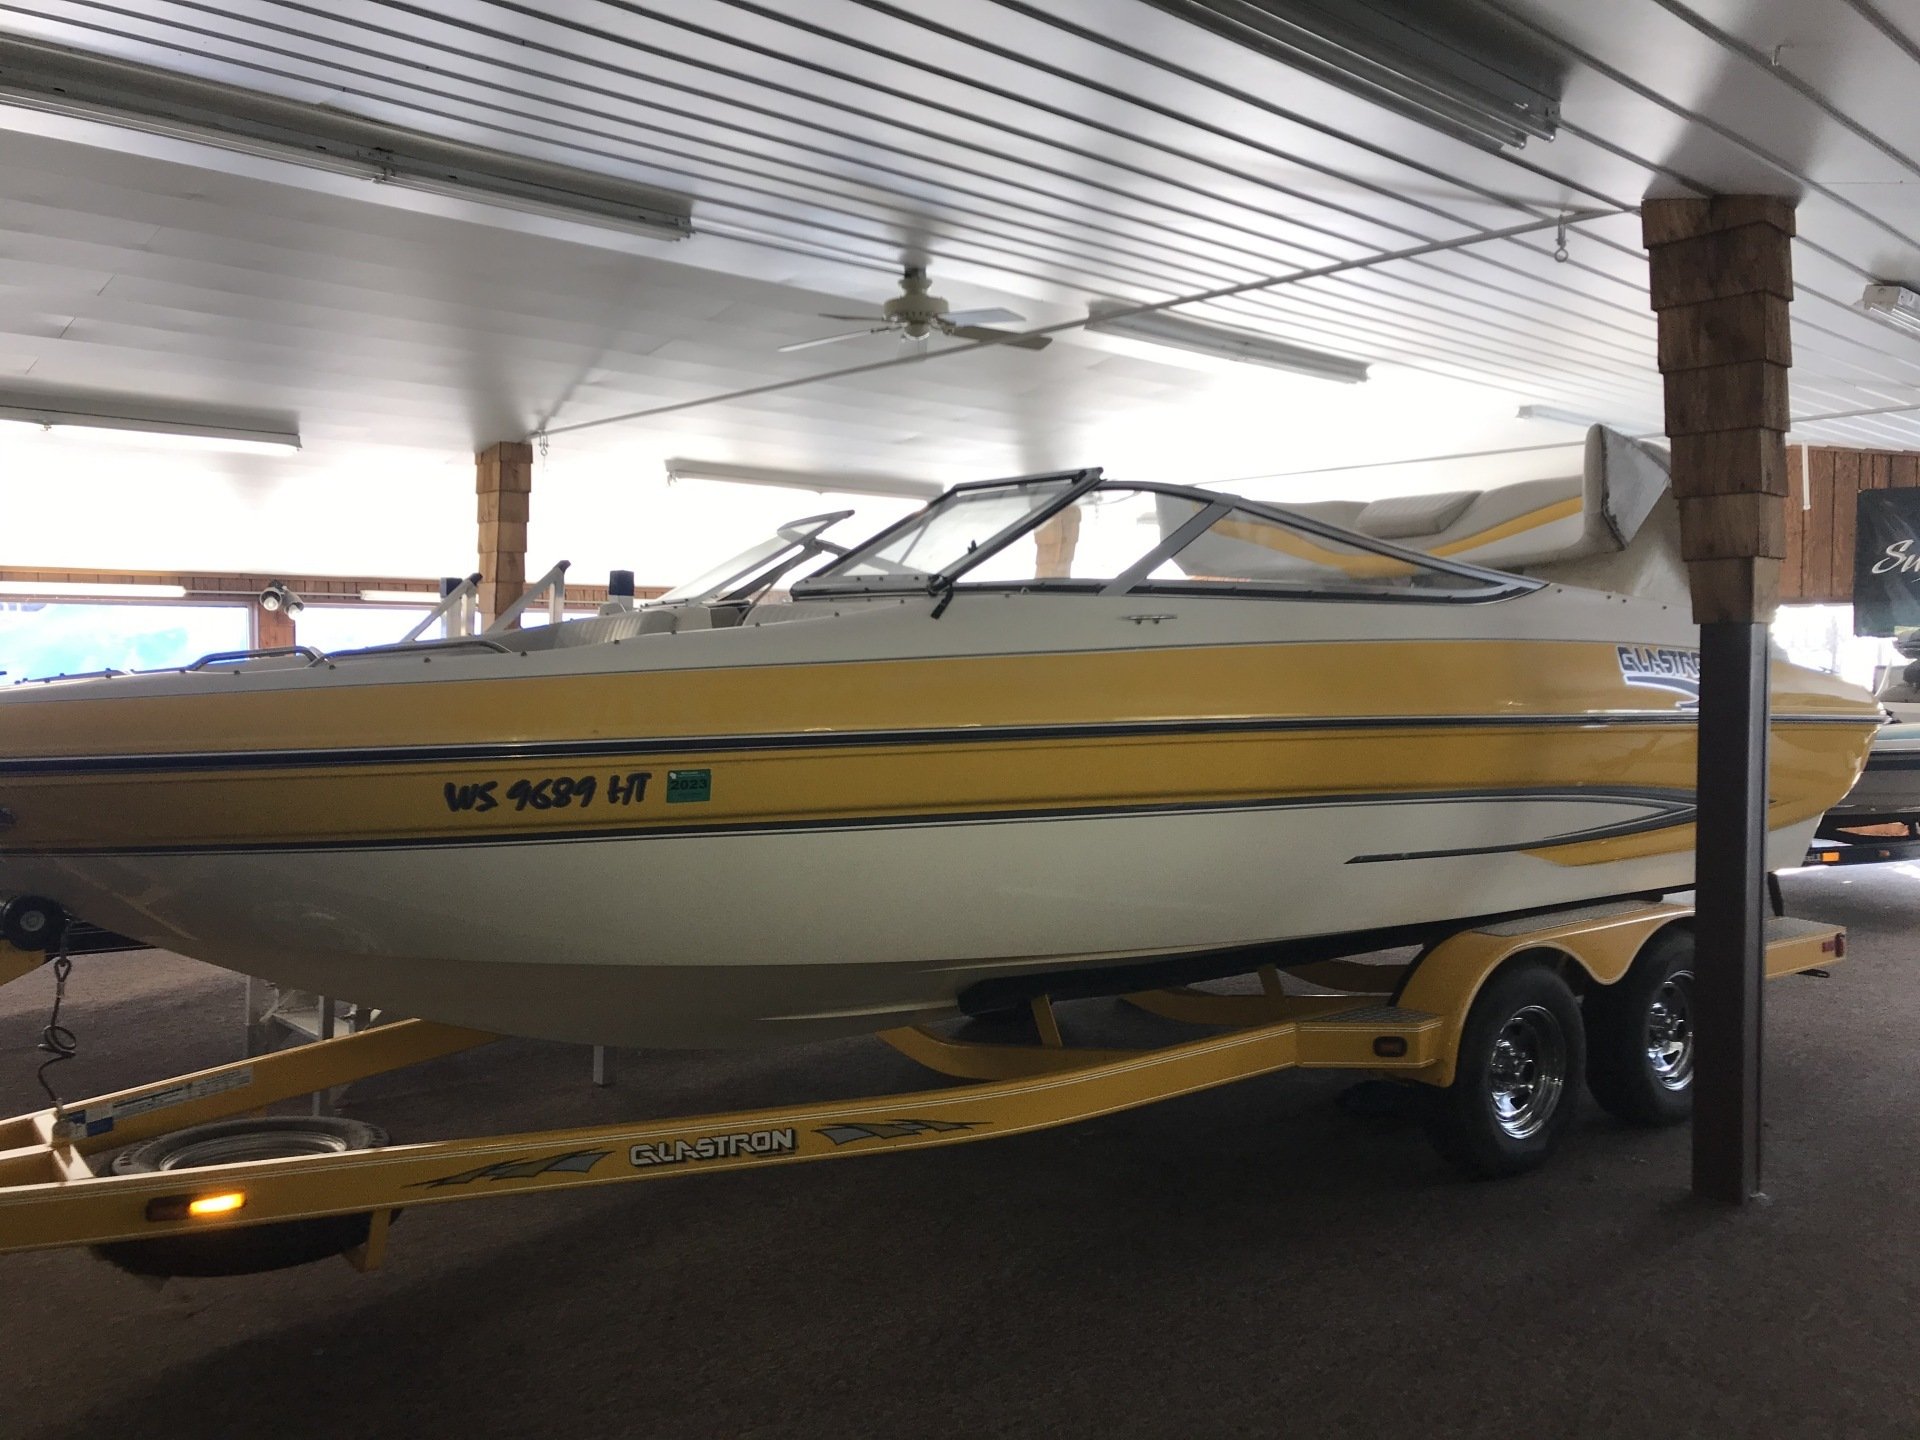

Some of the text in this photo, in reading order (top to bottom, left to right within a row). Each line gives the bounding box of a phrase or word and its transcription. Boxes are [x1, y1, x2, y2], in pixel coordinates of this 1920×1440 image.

[443, 772, 652, 812] WS 9689 HT
[629, 1127, 794, 1167] GLASTRON
